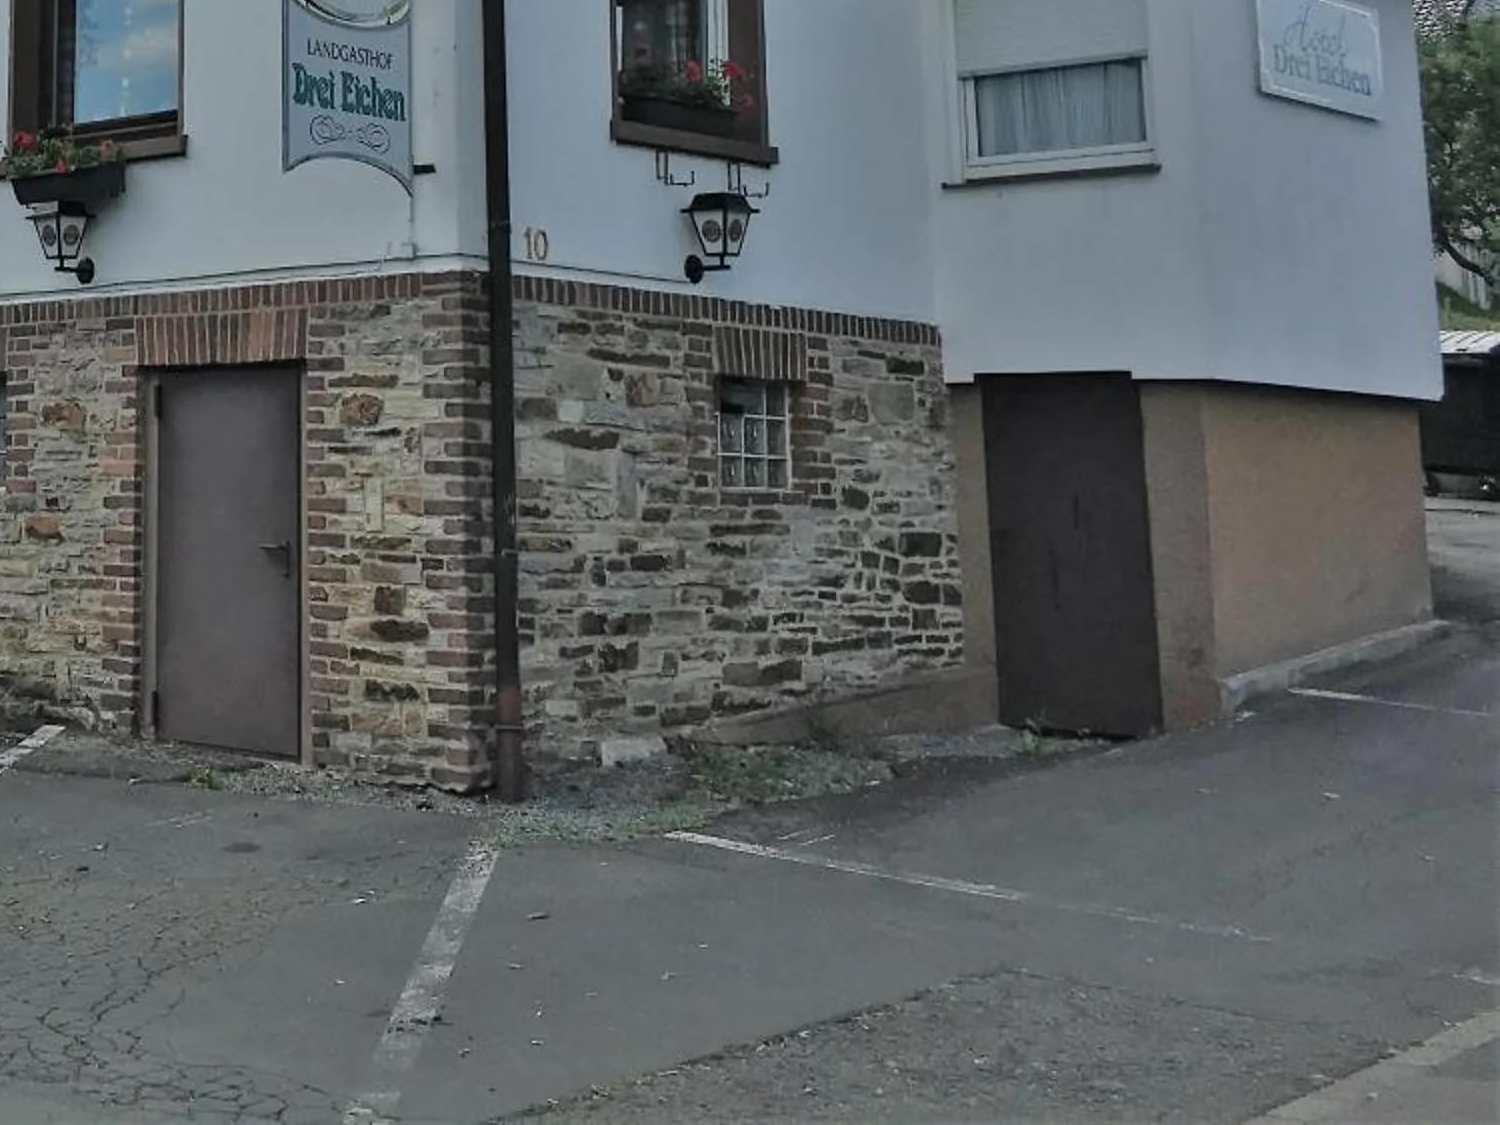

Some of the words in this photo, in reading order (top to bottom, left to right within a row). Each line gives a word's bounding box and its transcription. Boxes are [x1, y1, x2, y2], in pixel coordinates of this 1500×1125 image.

[306, 38, 394, 70] LANDGASTHOF
[1273, 43, 1312, 81] Drei
[1316, 53, 1373, 96] Eichen
[292, 62, 336, 109] Drei
[341, 71, 406, 121] Eichen
[524, 226, 548, 261] 10
